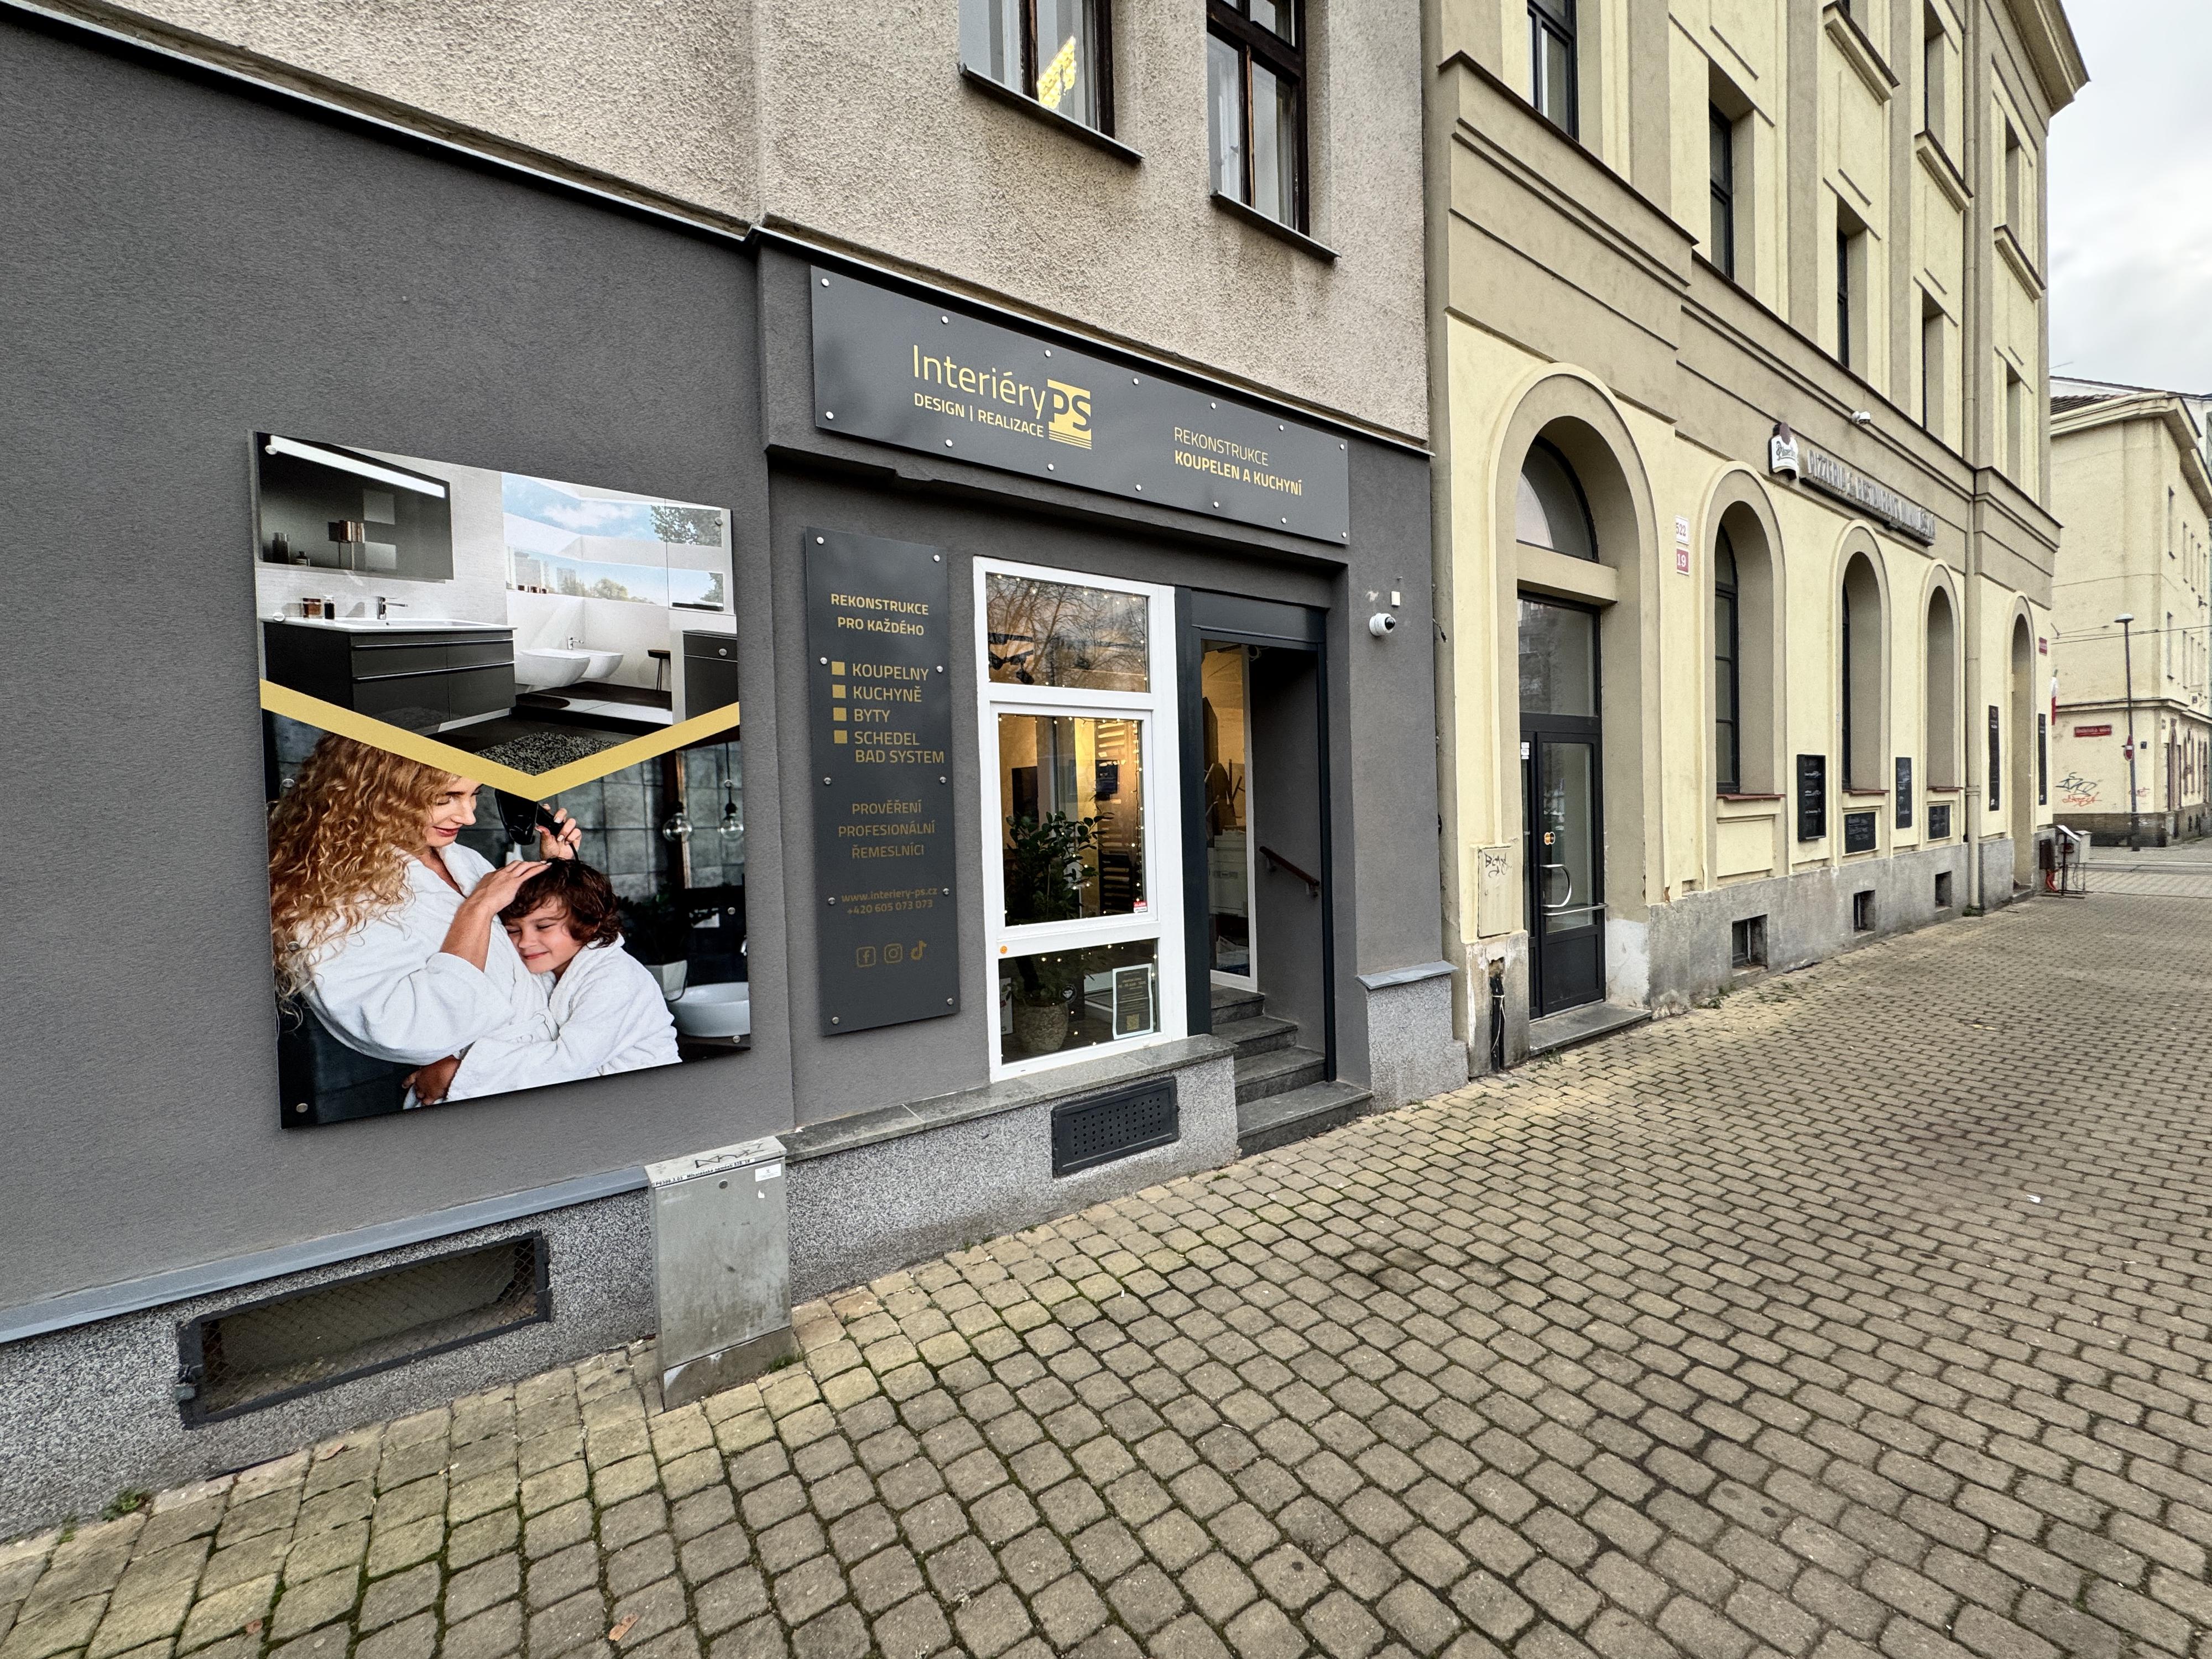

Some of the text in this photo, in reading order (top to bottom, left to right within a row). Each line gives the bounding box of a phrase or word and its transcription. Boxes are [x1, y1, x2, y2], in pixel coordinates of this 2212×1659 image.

[913, 345, 1046, 420] Interiéry
[914, 392, 965, 418] DESIGN
[978, 409, 1045, 438] REALIZACE
[1174, 426, 1269, 466] REKONSTRUKCE
[1175, 450, 1302, 496] KOUPELEN A KUCHYNÍ
[1677, 553, 1687, 567] 19
[831, 593, 929, 615] REKONSTRUKCE
[837, 616, 924, 636] PRO KAŽDÉHO
[852, 663, 929, 681] KOUPELNY
[853, 685, 922, 702] KUCHYNĚ
[854, 708, 891, 723] BYTY
[854, 731, 921, 745] SCHEDEL
[855, 749, 945, 764] BAD SYSTEM
[852, 799, 922, 815] PROVĚŘENÍ
[838, 820, 936, 837] PROFESIONÁLNÍ
[852, 842, 925, 859] ŘEMESLNÍCI
[841, 888, 938, 902] www.interiery-ps.cz
[847, 899, 933, 914] +420 605 073 073
